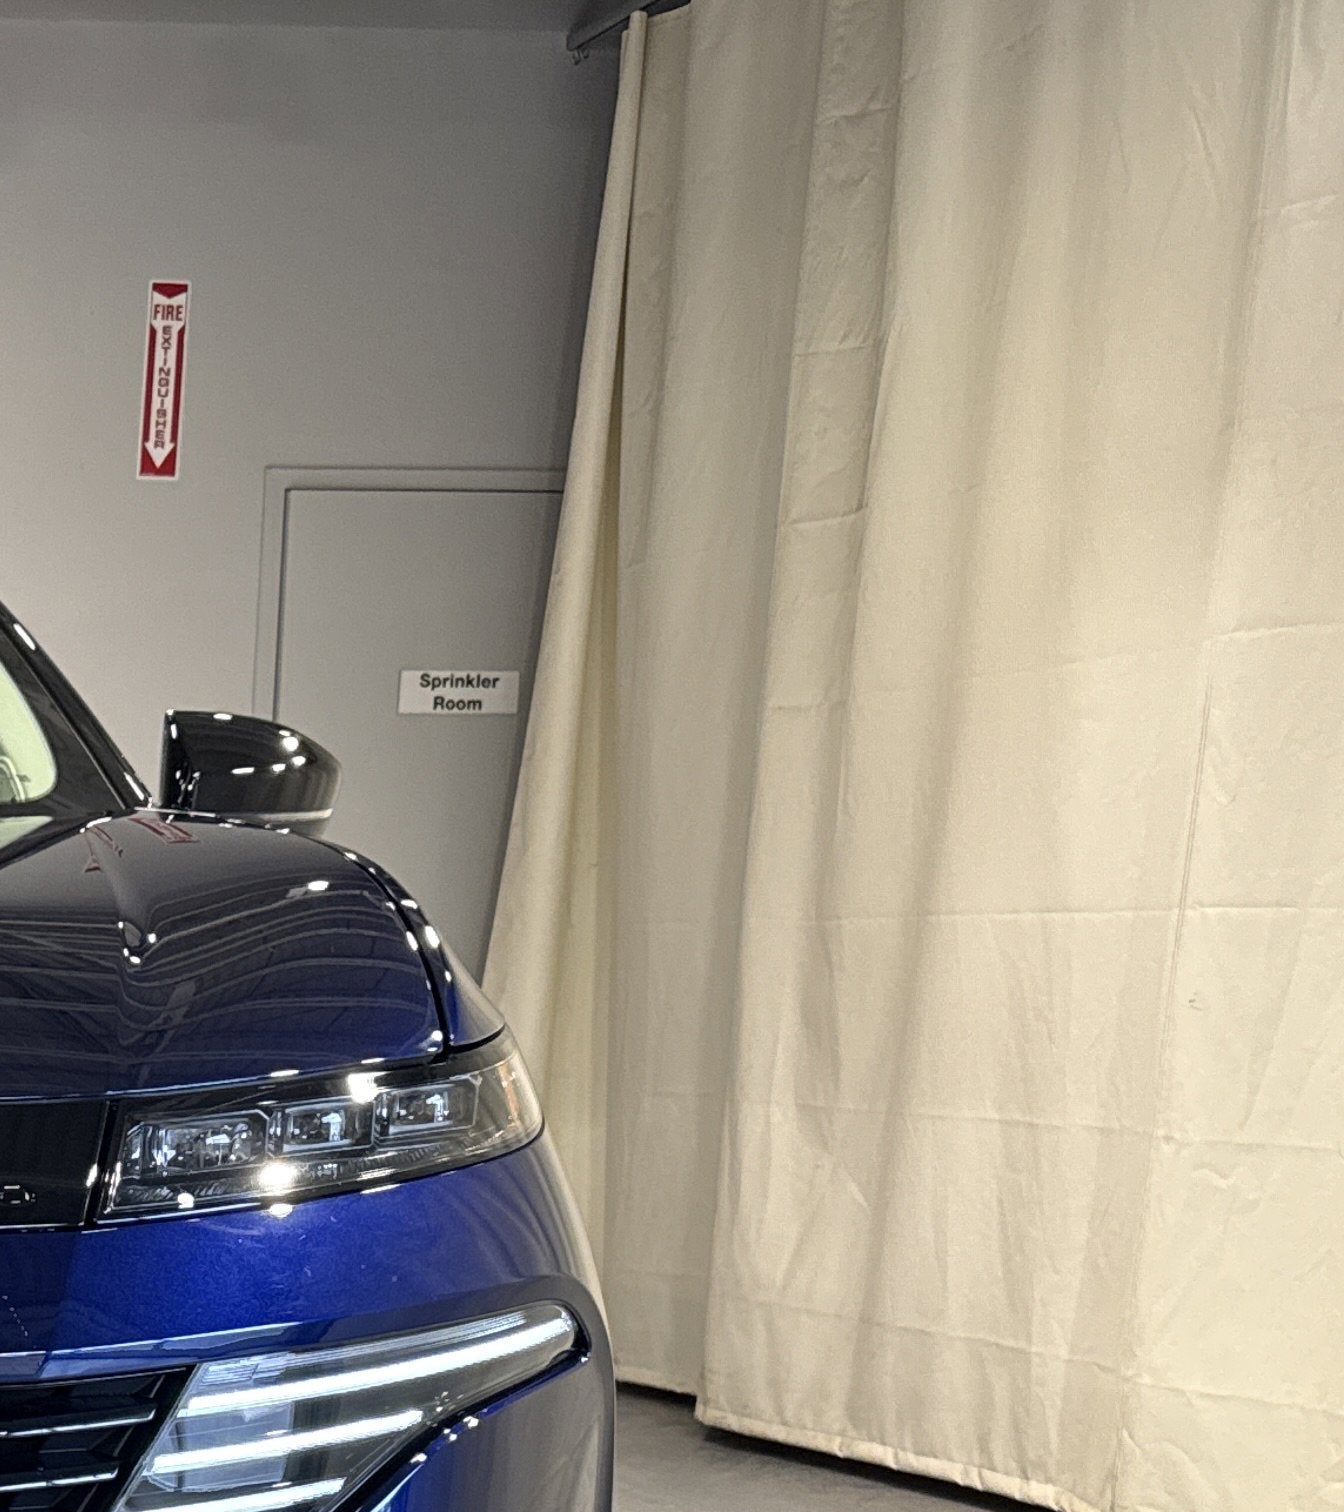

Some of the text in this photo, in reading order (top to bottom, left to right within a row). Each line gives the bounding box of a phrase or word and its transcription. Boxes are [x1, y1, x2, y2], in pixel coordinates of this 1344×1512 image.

[153, 304, 184, 322] FIRE
[153, 325, 173, 449] EXTINGUISHER
[419, 673, 500, 691] Sprinkler
[432, 696, 483, 711] Room
